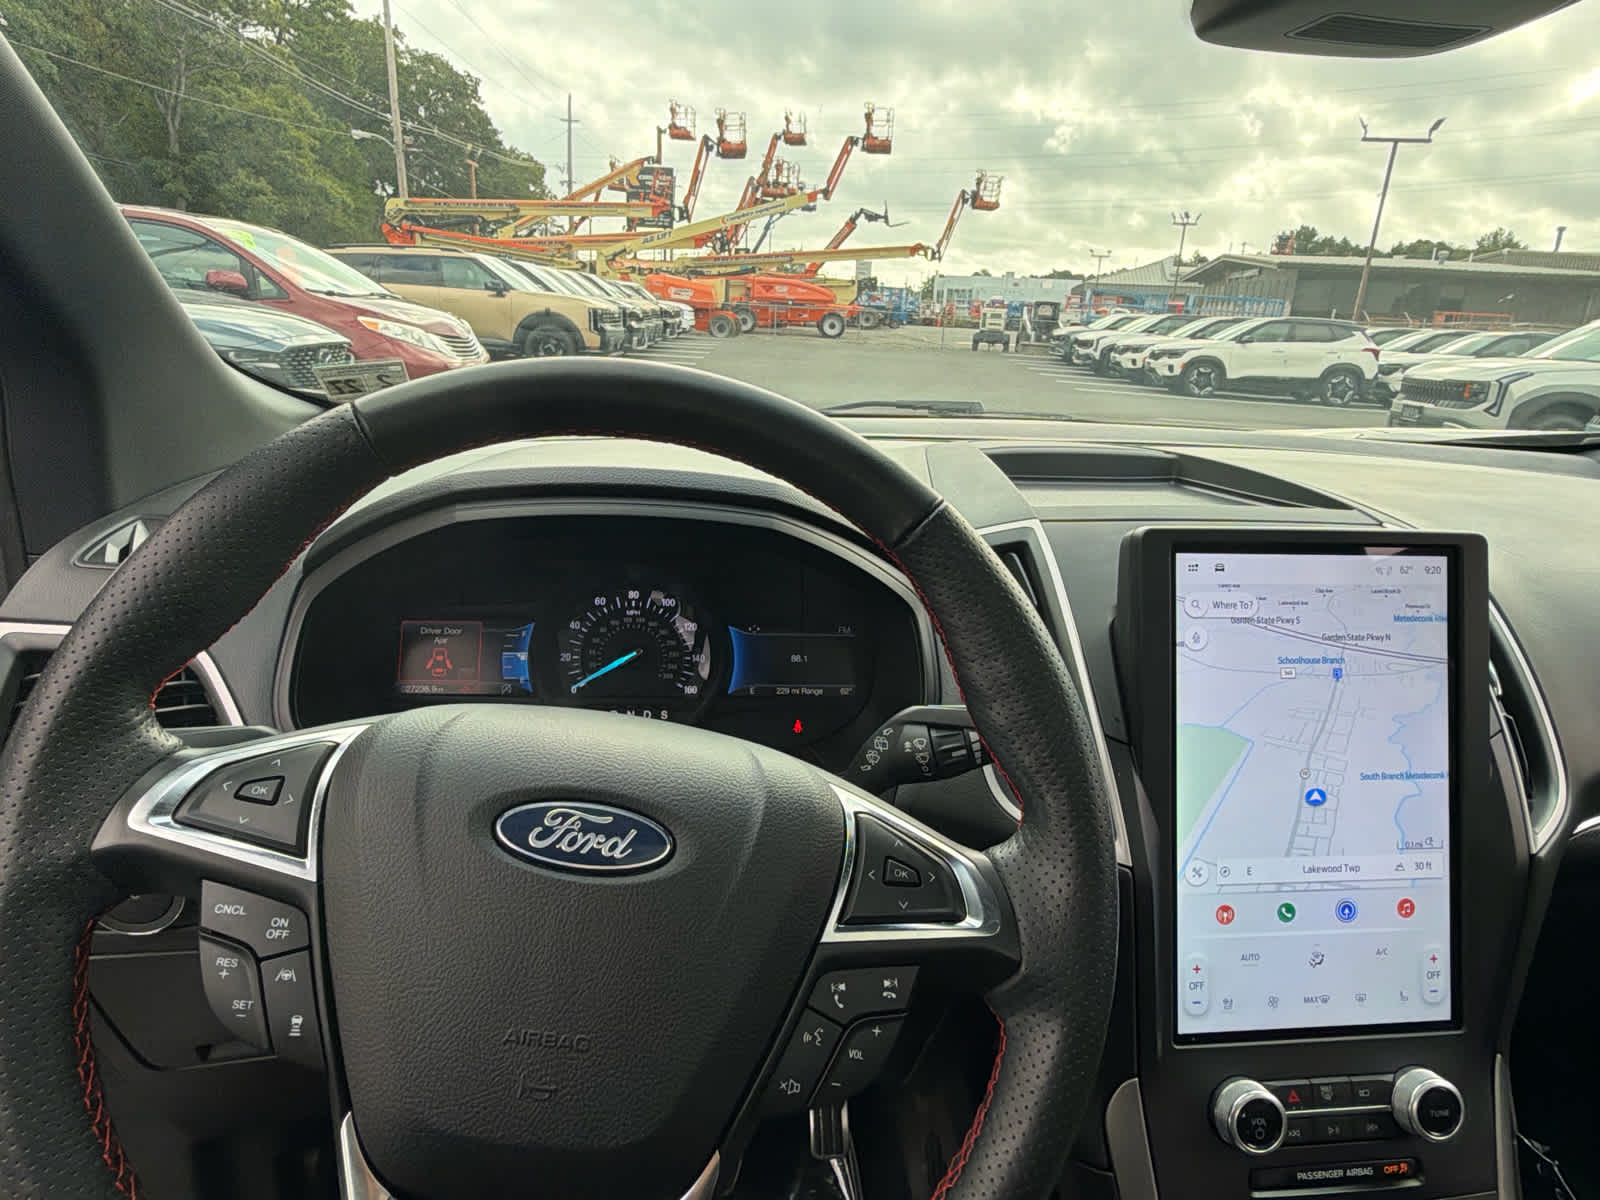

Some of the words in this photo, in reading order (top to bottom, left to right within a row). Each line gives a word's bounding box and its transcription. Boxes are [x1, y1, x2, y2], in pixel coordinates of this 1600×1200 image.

[1424, 565, 1442, 575] 9:20
[628, 590, 640, 600] 80
[594, 597, 606, 606] 60
[661, 598, 676, 607] 100
[1212, 600, 1237, 610] Where
[1239, 600, 1254, 610] To?
[569, 620, 581, 630] 40
[1231, 616, 1255, 625] Garden
[1256, 616, 1275, 625] State
[1276, 616, 1295, 626] Pkwy
[1296, 616, 1301, 625] S
[420, 626, 442, 635] Driver
[443, 626, 463, 635] Door
[684, 623, 697, 631] 120
[1321, 634, 1346, 642] Garden
[1347, 634, 1365, 642] State
[1366, 634, 1385, 643] Pkwy
[1386, 634, 1391, 642] N
[560, 652, 572, 662] 20
[692, 654, 706, 663] 140
[1277, 656, 1321, 665] Schoolhouse
[1322, 656, 1345, 665] Branch
[684, 685, 698, 695] 160
[801, 687, 824, 697] Range
[661, 711, 669, 720] S
[1360, 771, 1380, 781] South
[1381, 771, 1404, 780] Branch
[250, 785, 268, 795] OK
[528, 808, 638, 859] Ford
[1303, 864, 1340, 873] Lakewood
[1342, 864, 1361, 874] Twp
[1415, 862, 1425, 871] 30
[1426, 861, 1433, 871] ft
[893, 868, 909, 879] OK
[214, 903, 247, 916] CNCL
[270, 917, 289, 928] ON
[266, 929, 290, 940] OFF
[1240, 953, 1261, 962] AUTO
[1375, 948, 1389, 957] A/C
[215, 957, 239, 968] RES
[1427, 970, 1441, 980] OFF
[1188, 981, 1205, 991] OFF
[232, 999, 254, 1010] SET
[1303, 995, 1318, 1004] MAX
[848, 1049, 864, 1061] VOL
[1296, 1168, 1344, 1181] PASSENGER
[1346, 1166, 1374, 1178] AIRBAG
[1383, 1164, 1399, 1175] OFF
